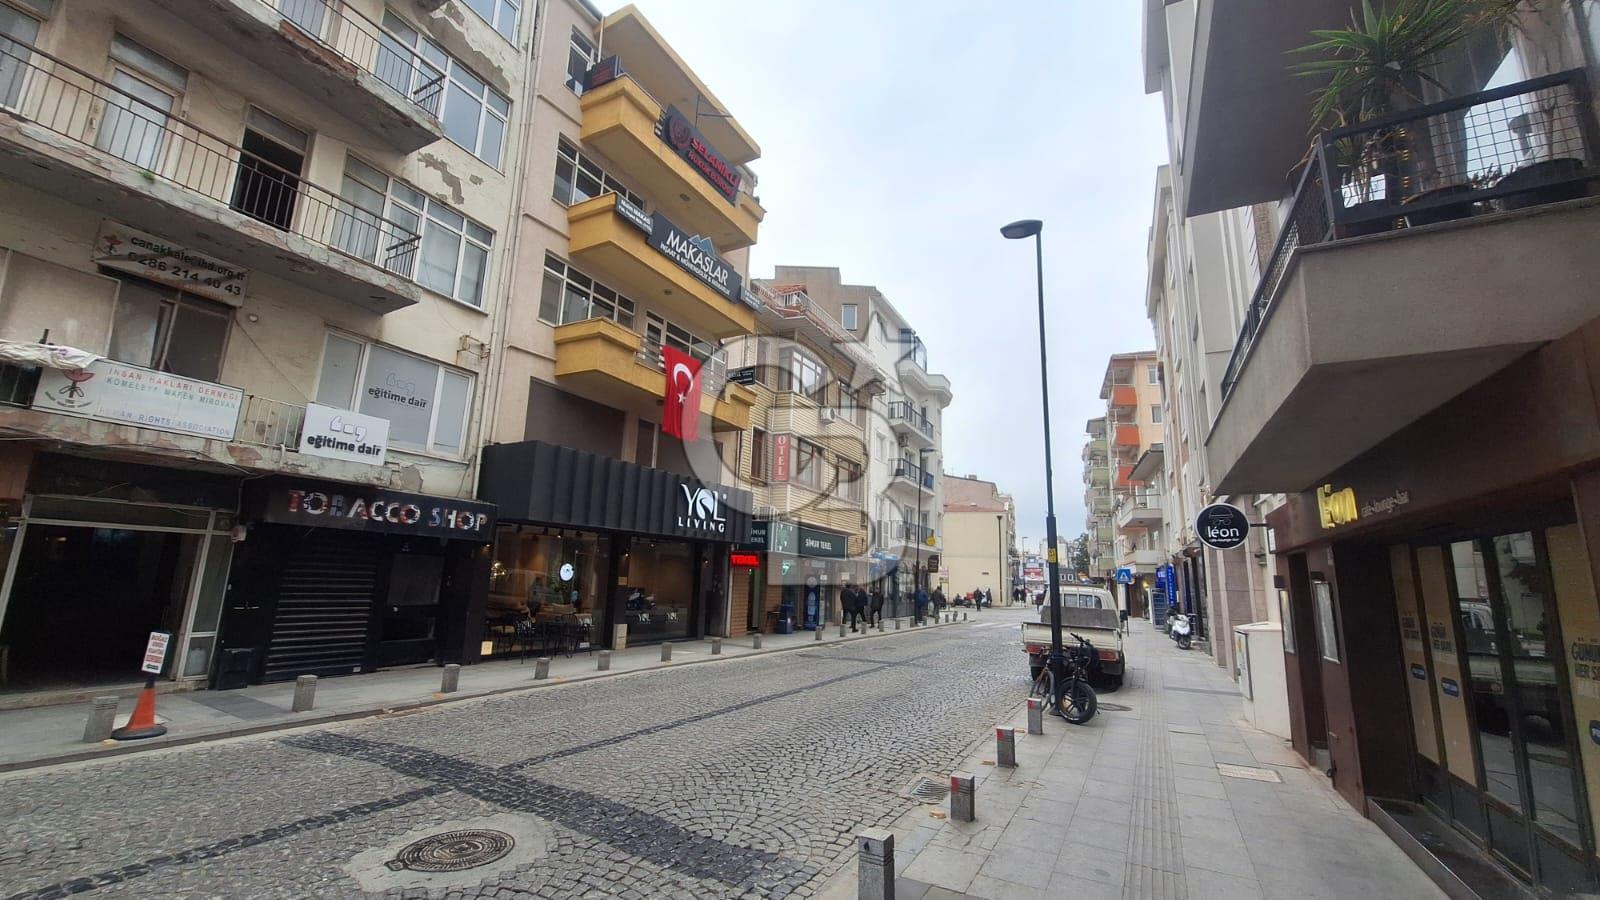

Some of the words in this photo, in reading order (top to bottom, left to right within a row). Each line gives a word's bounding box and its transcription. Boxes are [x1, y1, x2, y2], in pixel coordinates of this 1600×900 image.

[666, 230, 728, 286] MAKASLAR
[171, 266, 199, 281] 214
[225, 284, 241, 296] 43
[368, 387, 406, 402] eğitime
[408, 397, 427, 408] dair
[307, 434, 355, 452] eğitime
[357, 443, 381, 456] dair
[778, 435, 786, 476] OTEL
[288, 489, 421, 525] TOBACCO
[428, 507, 488, 532] SHOP
[678, 517, 725, 533] LIVING
[1208, 526, 1239, 538] léon
